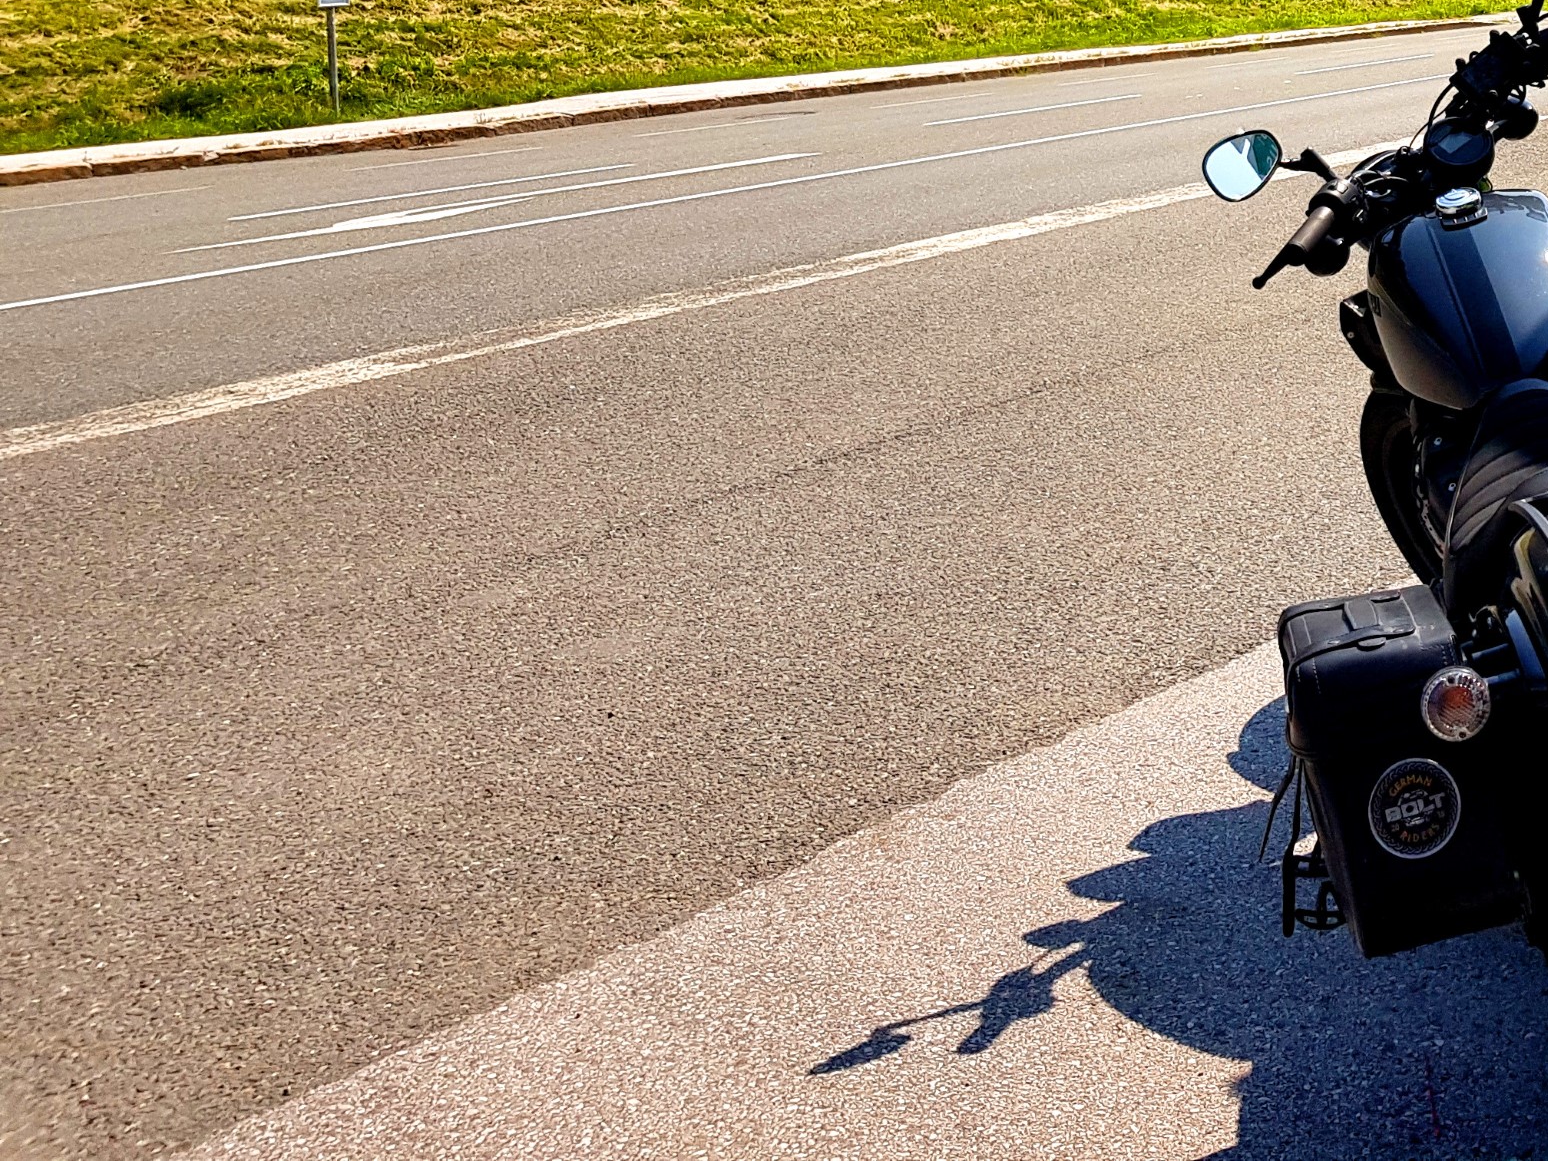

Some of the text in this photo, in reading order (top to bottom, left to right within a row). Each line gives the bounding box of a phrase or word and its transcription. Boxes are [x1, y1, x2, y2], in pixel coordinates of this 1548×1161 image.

[1389, 774, 1433, 797] GERMAN
[1384, 791, 1446, 823] BOLT
[1400, 823, 1440, 842] RIDERS
